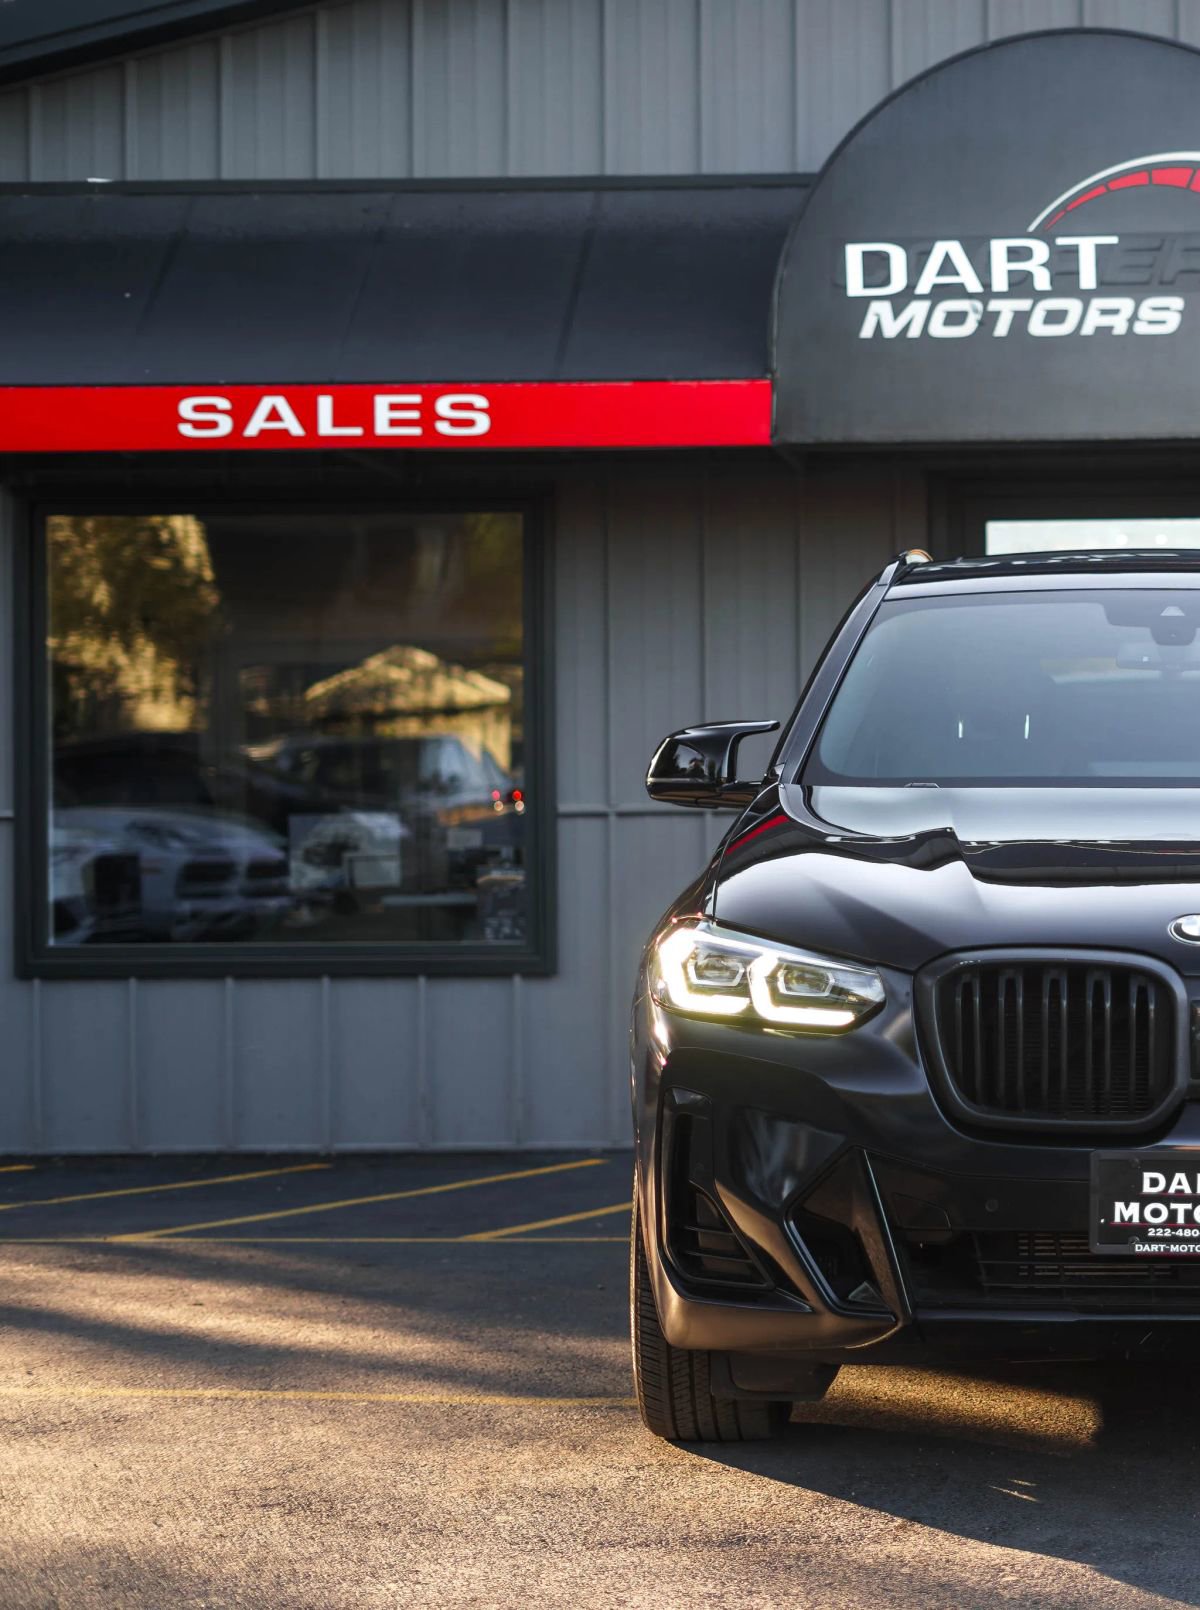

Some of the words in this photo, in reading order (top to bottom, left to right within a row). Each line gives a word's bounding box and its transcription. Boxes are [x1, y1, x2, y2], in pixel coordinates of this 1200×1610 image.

[845, 236, 1119, 297] DART
[859, 297, 1185, 339] MOTORS
[177, 394, 491, 438] SALES
